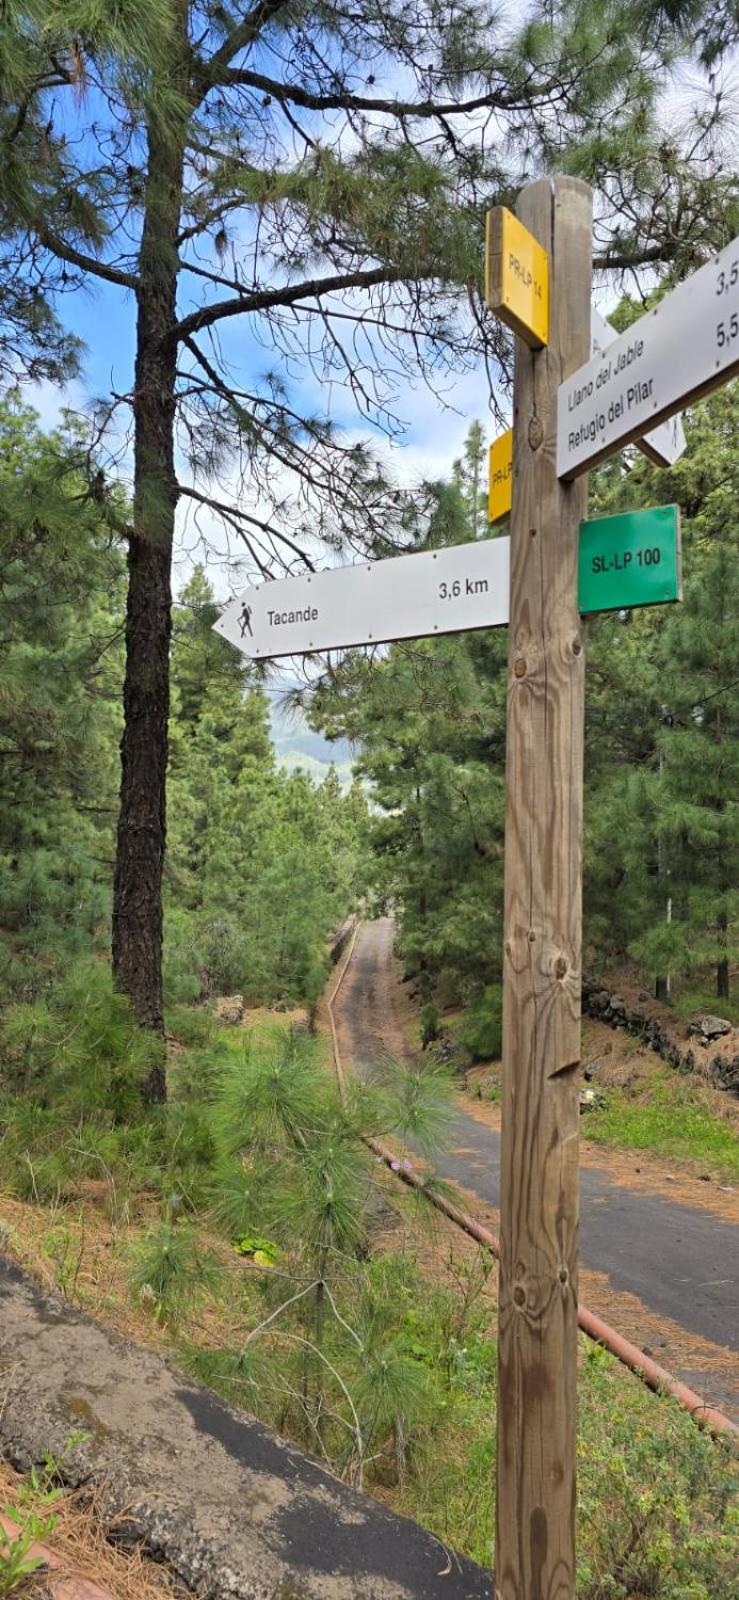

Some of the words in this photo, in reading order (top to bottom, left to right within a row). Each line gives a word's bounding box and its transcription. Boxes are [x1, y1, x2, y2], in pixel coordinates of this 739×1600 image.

[509, 252, 533, 288] PR-LP
[533, 280, 542, 301] 14
[568, 380, 594, 412] Llano
[596, 361, 612, 390] del
[613, 340, 644, 376] Jable
[716, 260, 739, 296] 3,5
[568, 413, 606, 452] Refugio
[608, 394, 624, 424] del
[627, 378, 654, 410] Pilar
[716, 312, 739, 348] 5,5
[592, 552, 632, 574] SL-LP
[636, 547, 661, 566] 100
[267, 604, 319, 627] Tacande
[439, 580, 461, 601] 3,6
[465, 577, 489, 596] km
